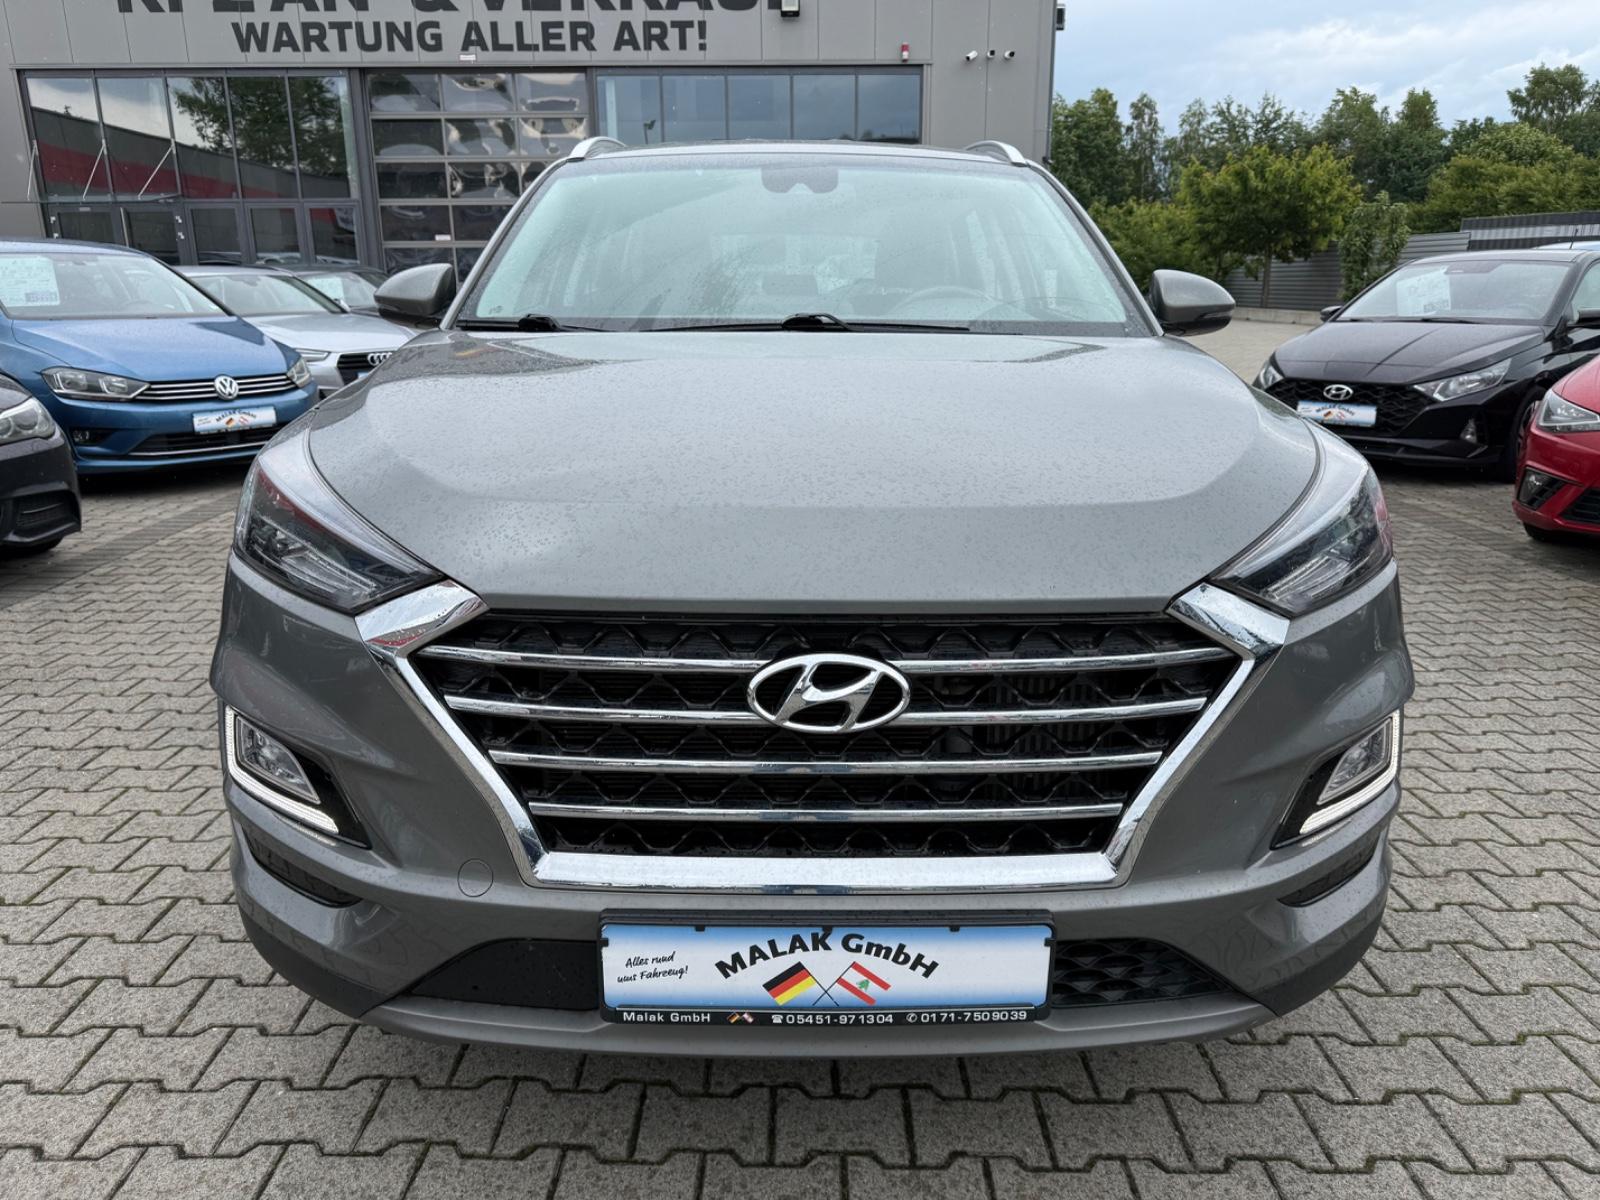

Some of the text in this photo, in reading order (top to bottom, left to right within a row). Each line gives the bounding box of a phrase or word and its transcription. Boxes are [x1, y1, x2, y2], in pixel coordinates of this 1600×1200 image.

[231, 20, 708, 54] WARTUNG ALLER ART!
[625, 950, 676, 968] Alles rund
[715, 931, 939, 979] MALAK GmbH
[639, 965, 689, 980] Fahrzeug!
[623, 1010, 1027, 1025] Malak GmbH 05451-971304 0171-7509039
